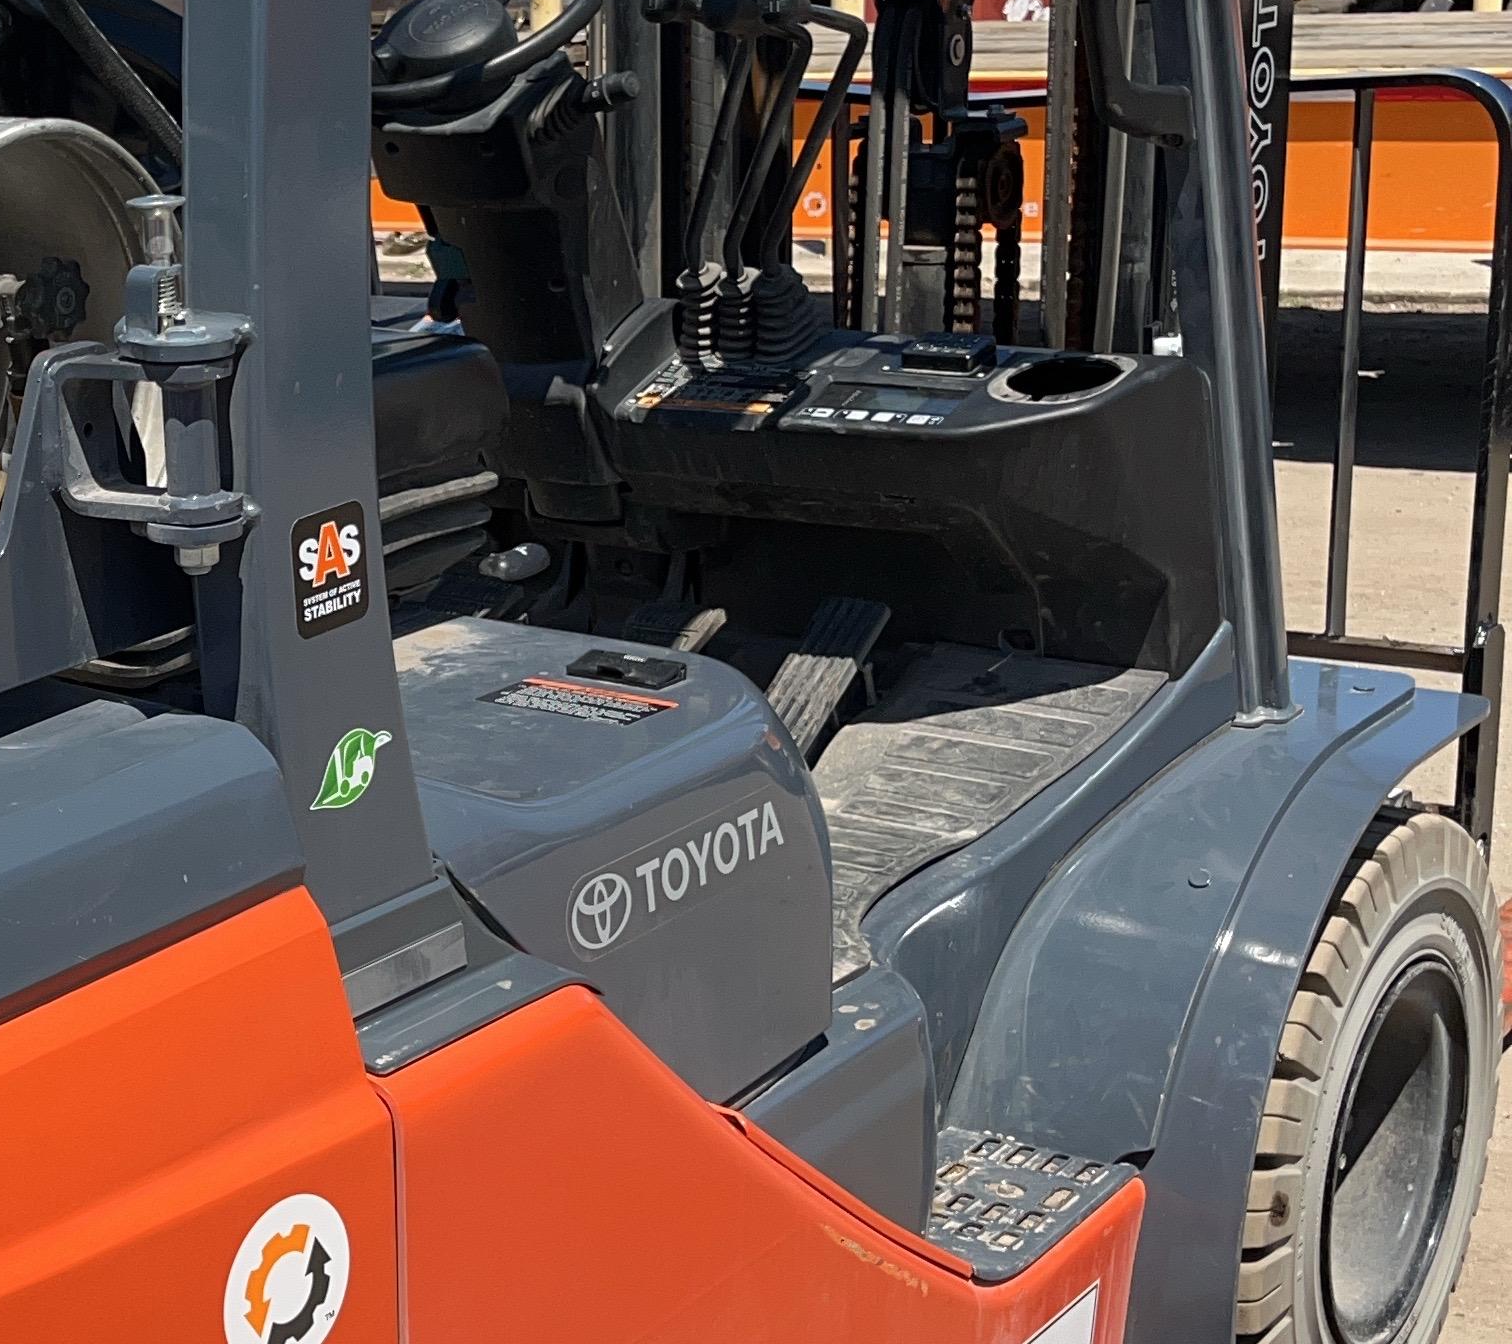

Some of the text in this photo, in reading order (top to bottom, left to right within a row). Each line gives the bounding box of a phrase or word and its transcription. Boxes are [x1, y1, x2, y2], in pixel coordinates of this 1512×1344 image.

[298, 520, 362, 589] SAS
[303, 590, 329, 608] SYSTEM
[303, 588, 362, 623] STABILITY
[633, 800, 785, 914] TOYOTA
